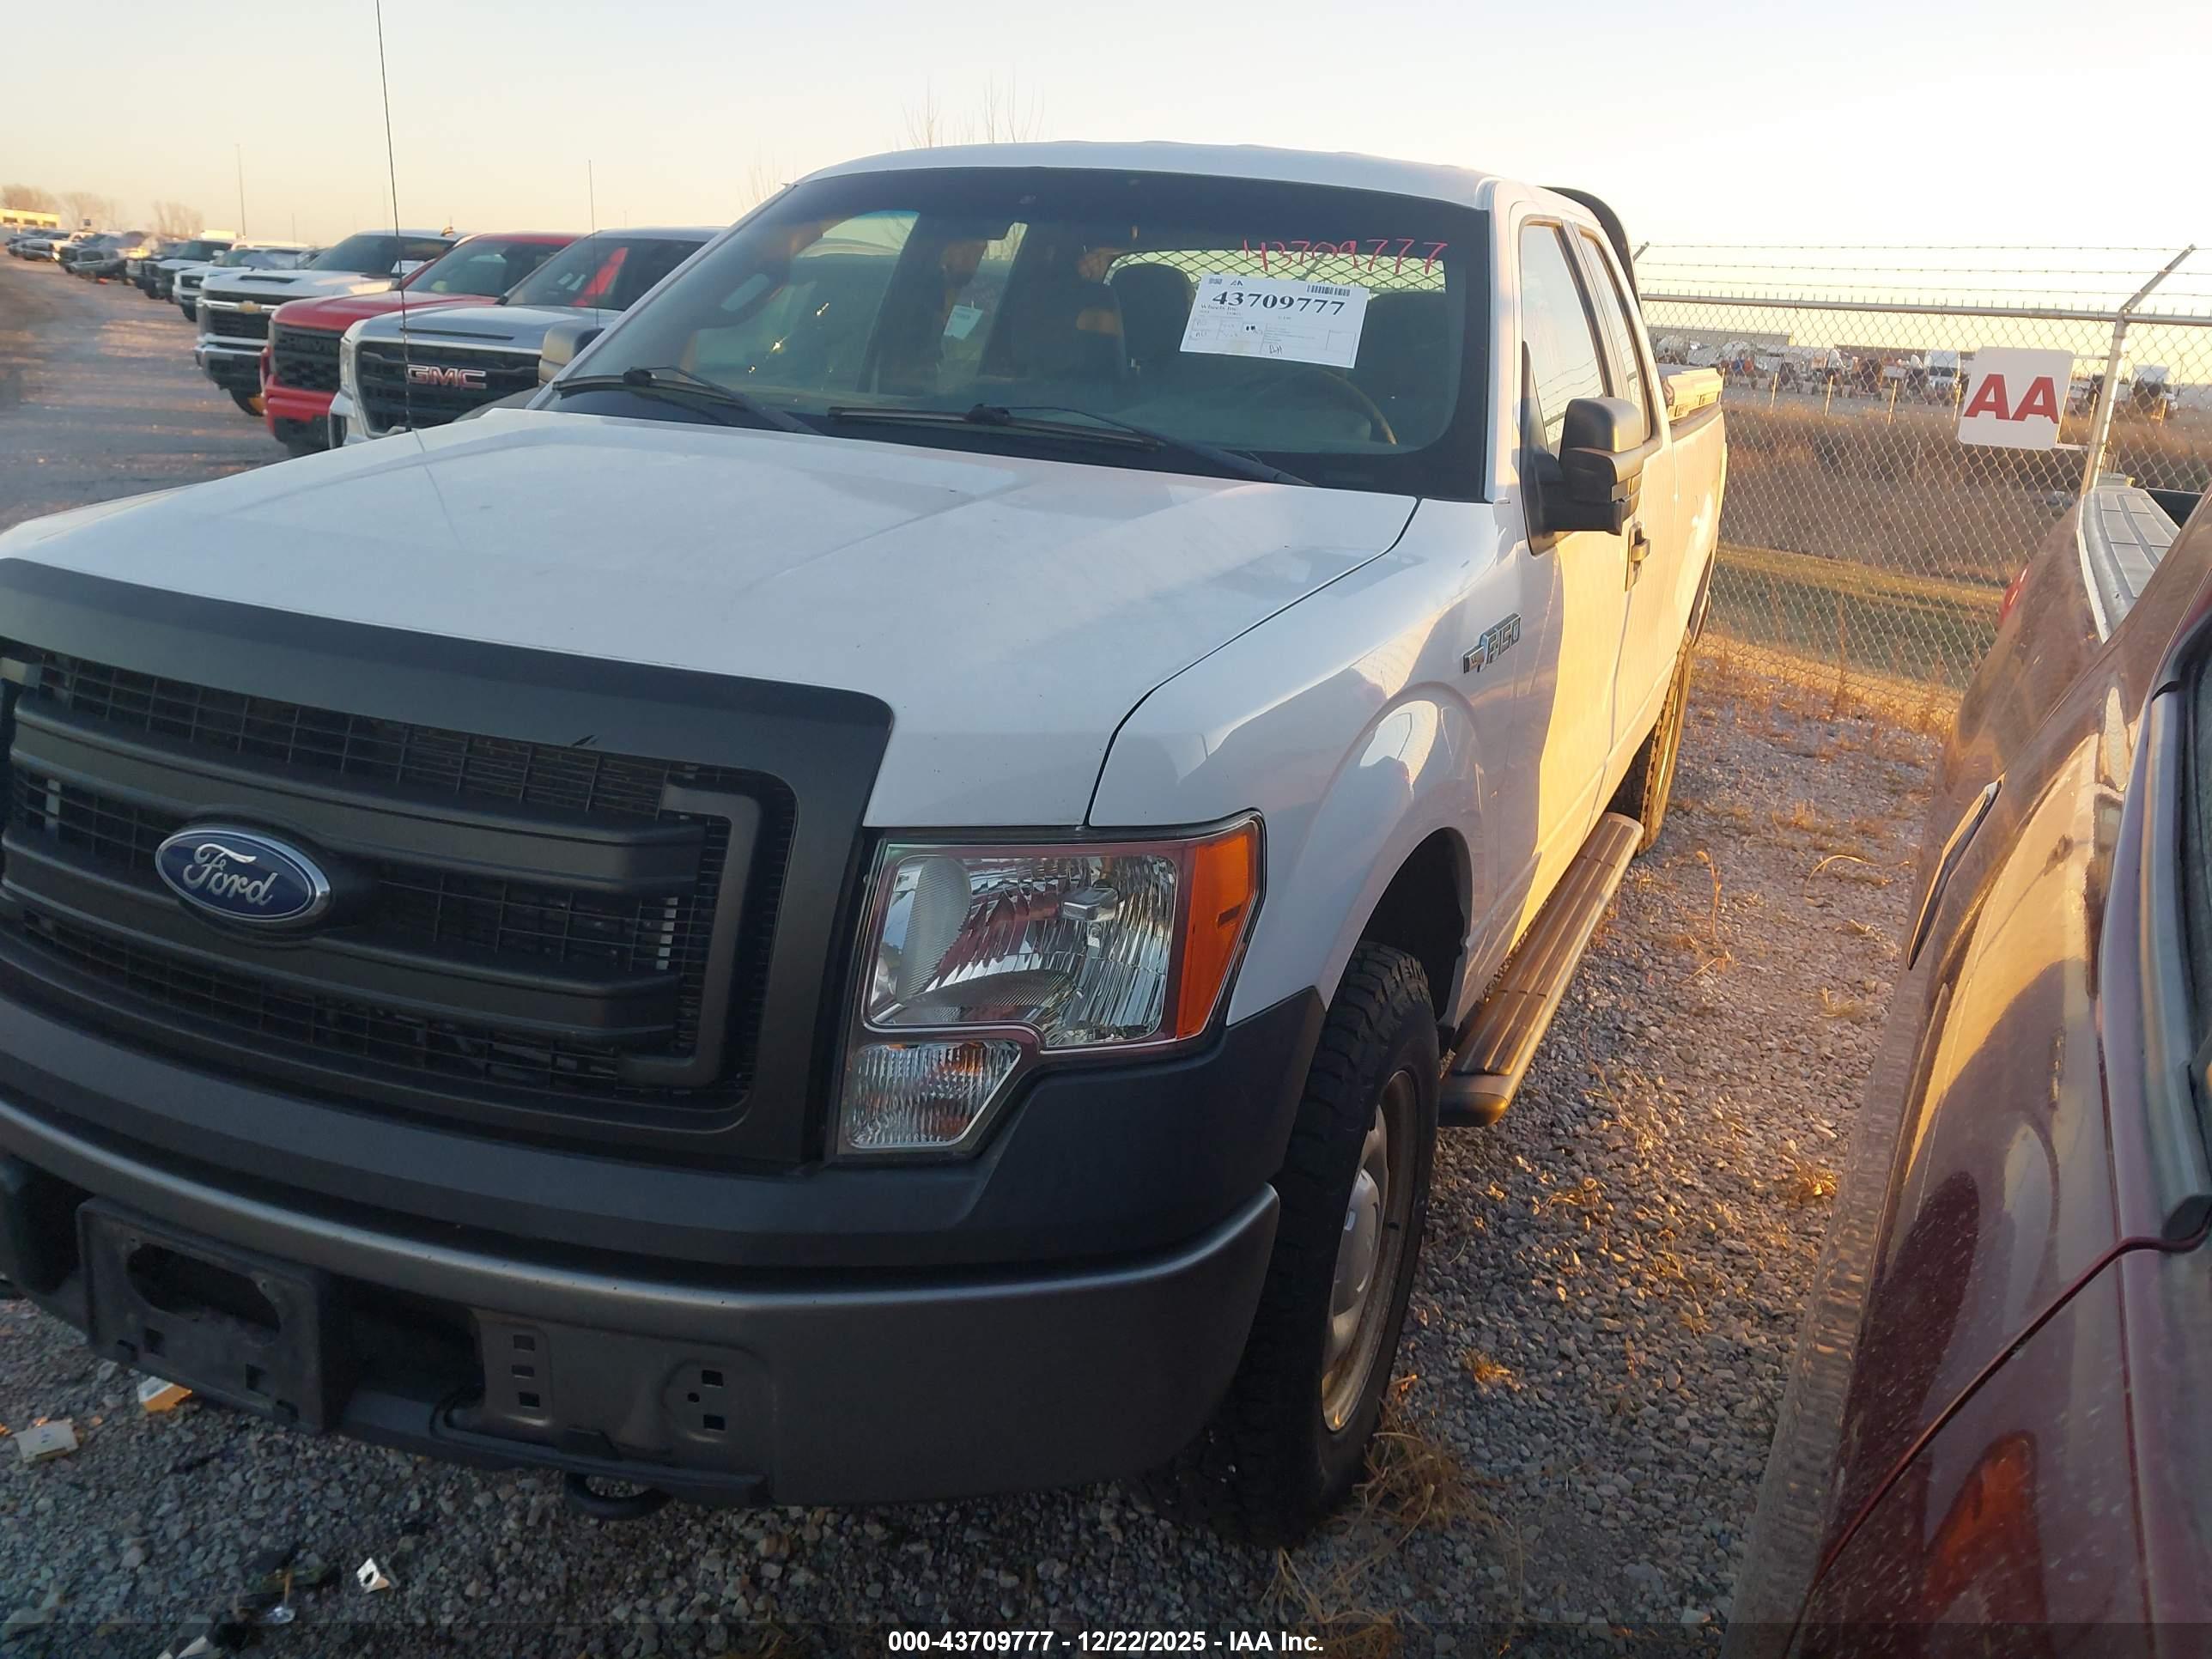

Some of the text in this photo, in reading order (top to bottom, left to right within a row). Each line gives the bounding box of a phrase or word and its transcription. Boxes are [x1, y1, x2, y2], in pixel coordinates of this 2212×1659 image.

[1243, 239, 1449, 276] 43709777
[1212, 290, 1346, 316] 43709777
[408, 364, 488, 390] GMC
[1963, 373, 2060, 425] AA
[182, 842, 279, 907] Ford
